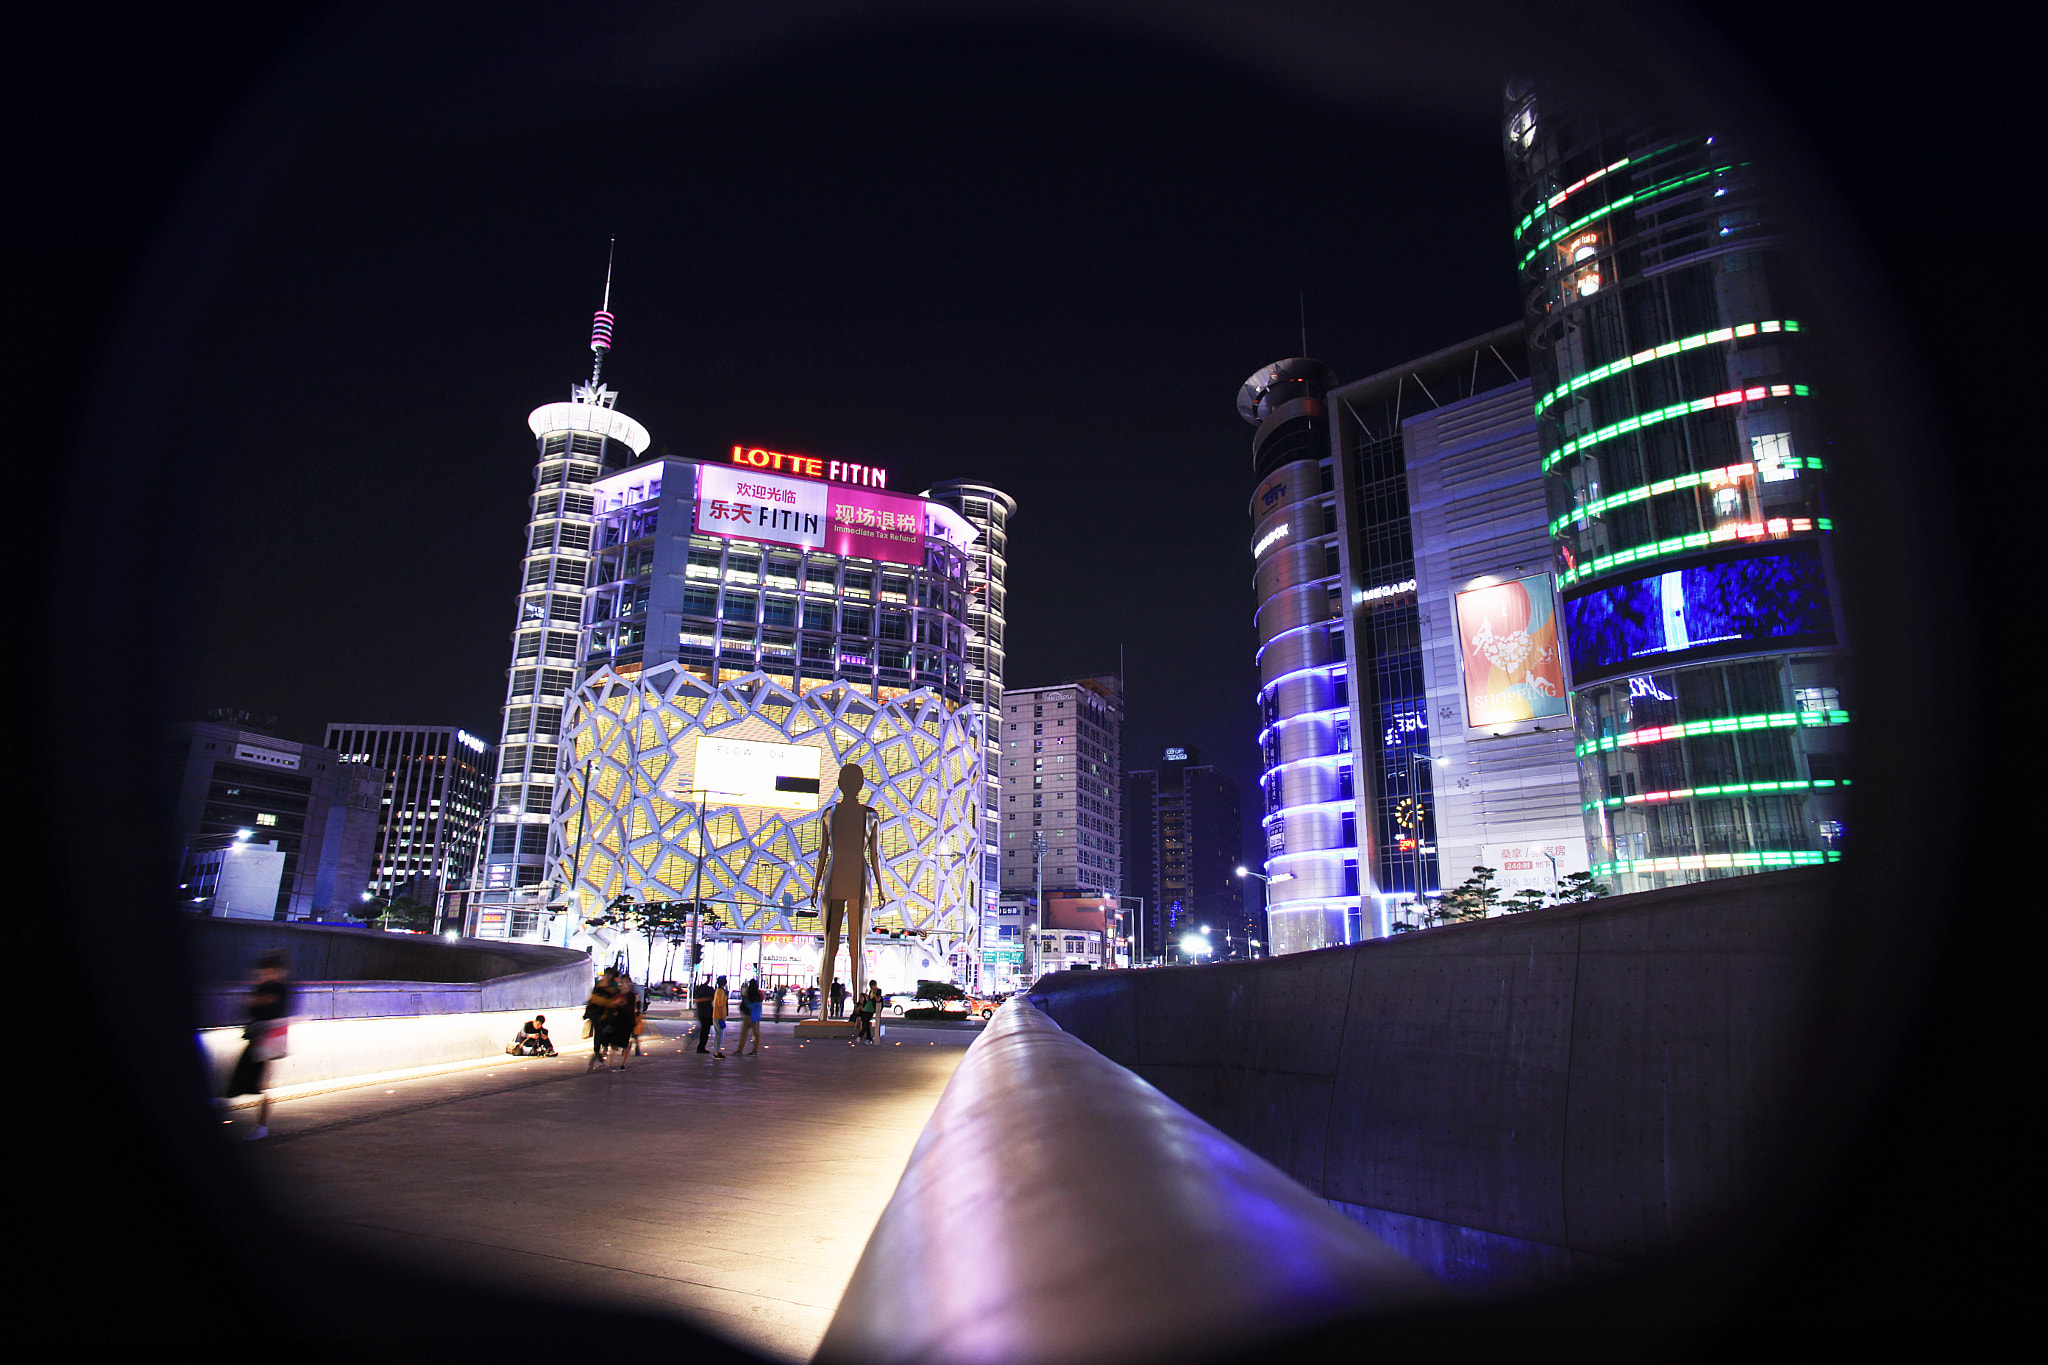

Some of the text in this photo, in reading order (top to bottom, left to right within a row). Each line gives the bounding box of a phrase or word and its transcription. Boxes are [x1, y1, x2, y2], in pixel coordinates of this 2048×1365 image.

[733, 445, 887, 489] LOTTE FITIN
[736, 482, 797, 505] 欢迎光临
[709, 499, 818, 535] 乐天 FITIN
[835, 503, 917, 534] 现场退税
[834, 524, 917, 544] Immediate Tax Refund
[1474, 684, 1557, 708] SHOPPING
[763, 935, 793, 944] LOTTE
